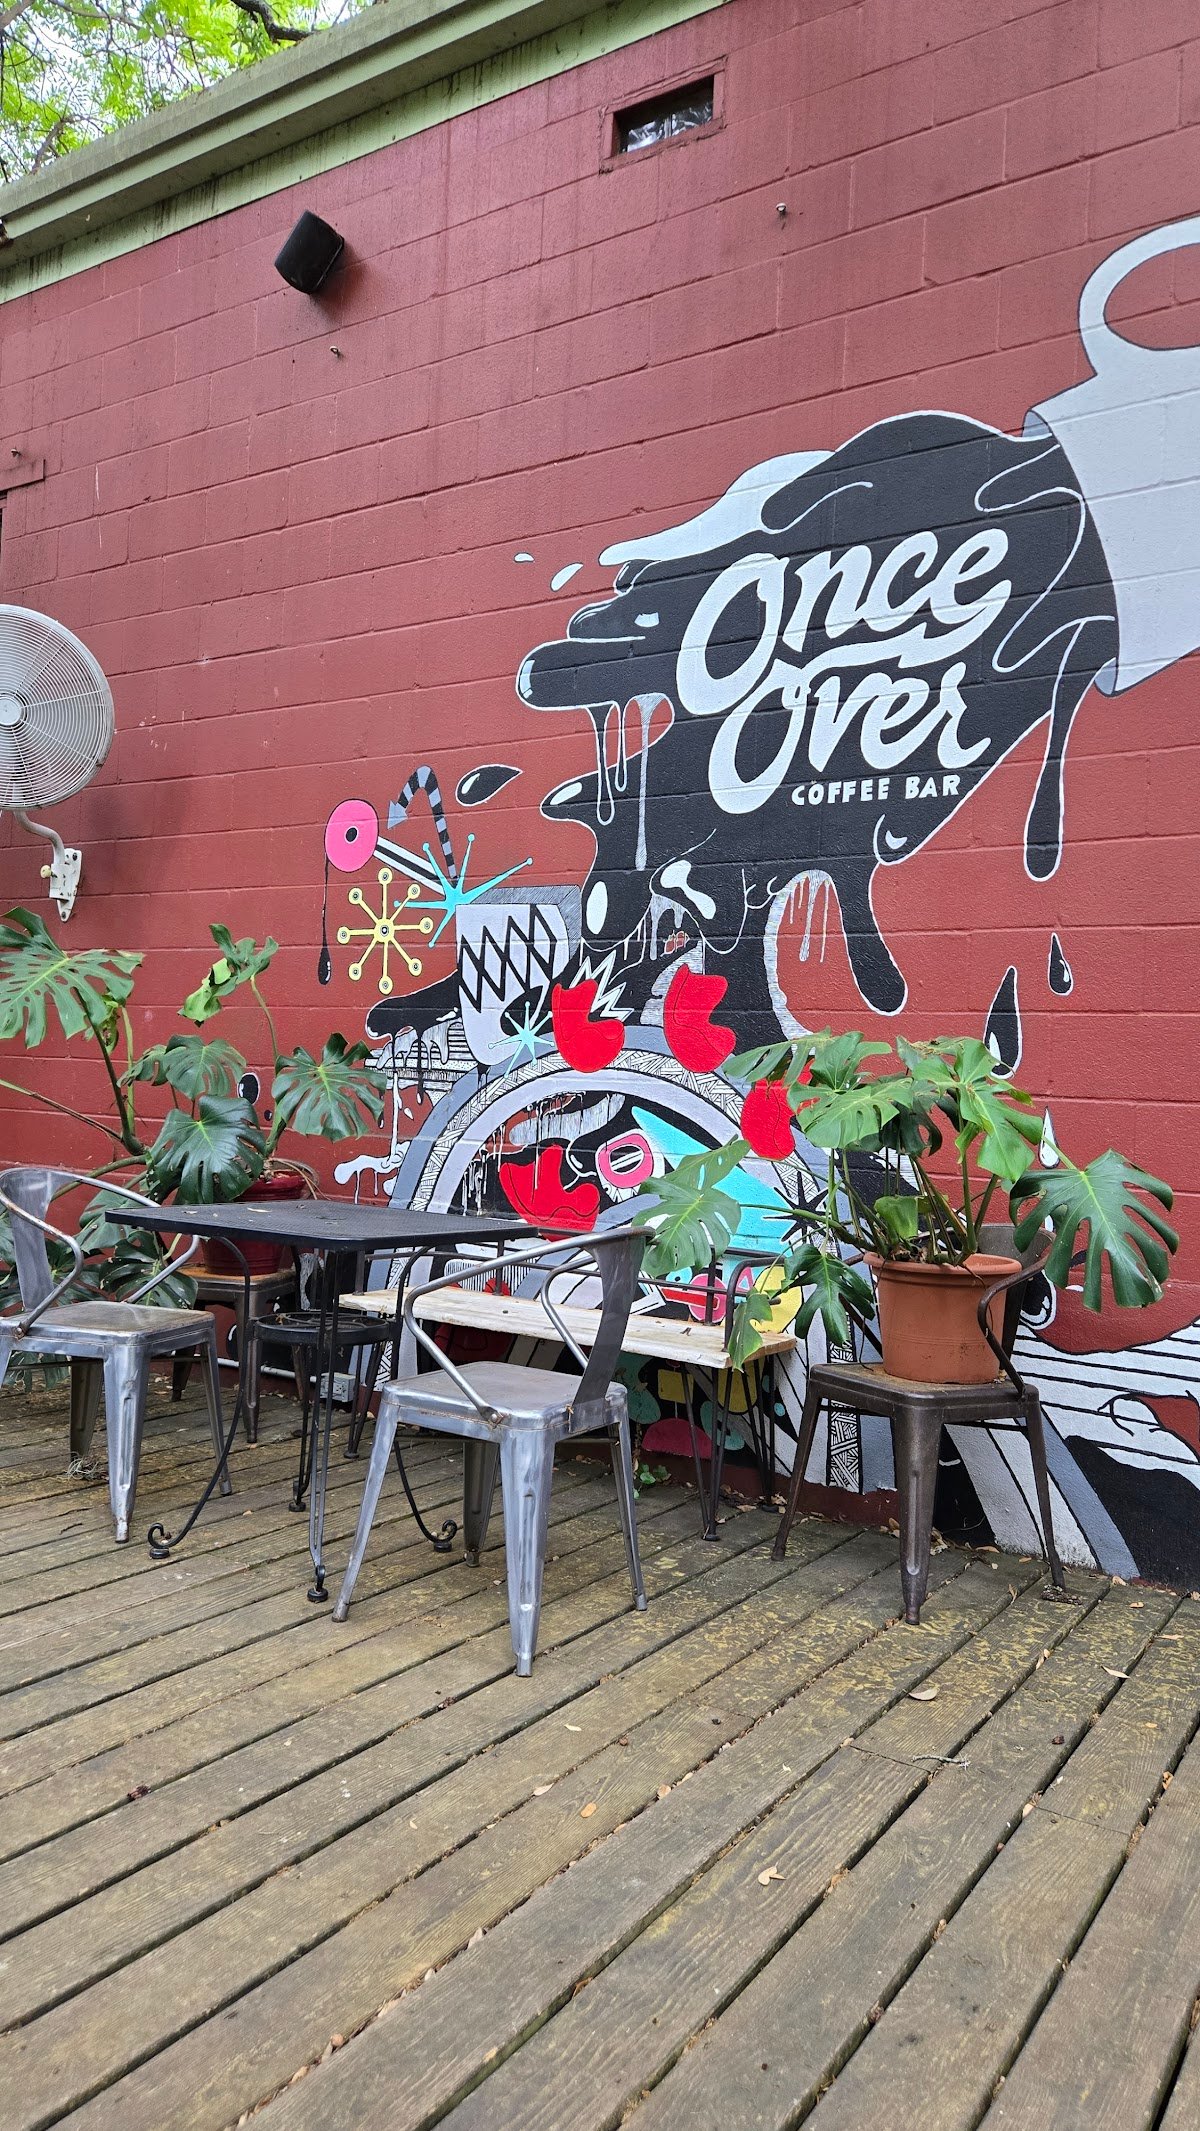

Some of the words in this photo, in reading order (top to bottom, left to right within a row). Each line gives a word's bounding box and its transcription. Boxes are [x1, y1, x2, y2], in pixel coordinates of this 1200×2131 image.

[676, 529, 1012, 715] Once
[708, 658, 991, 814] Over
[791, 778, 890, 805] COFFEE
[905, 774, 961, 799] BAR
